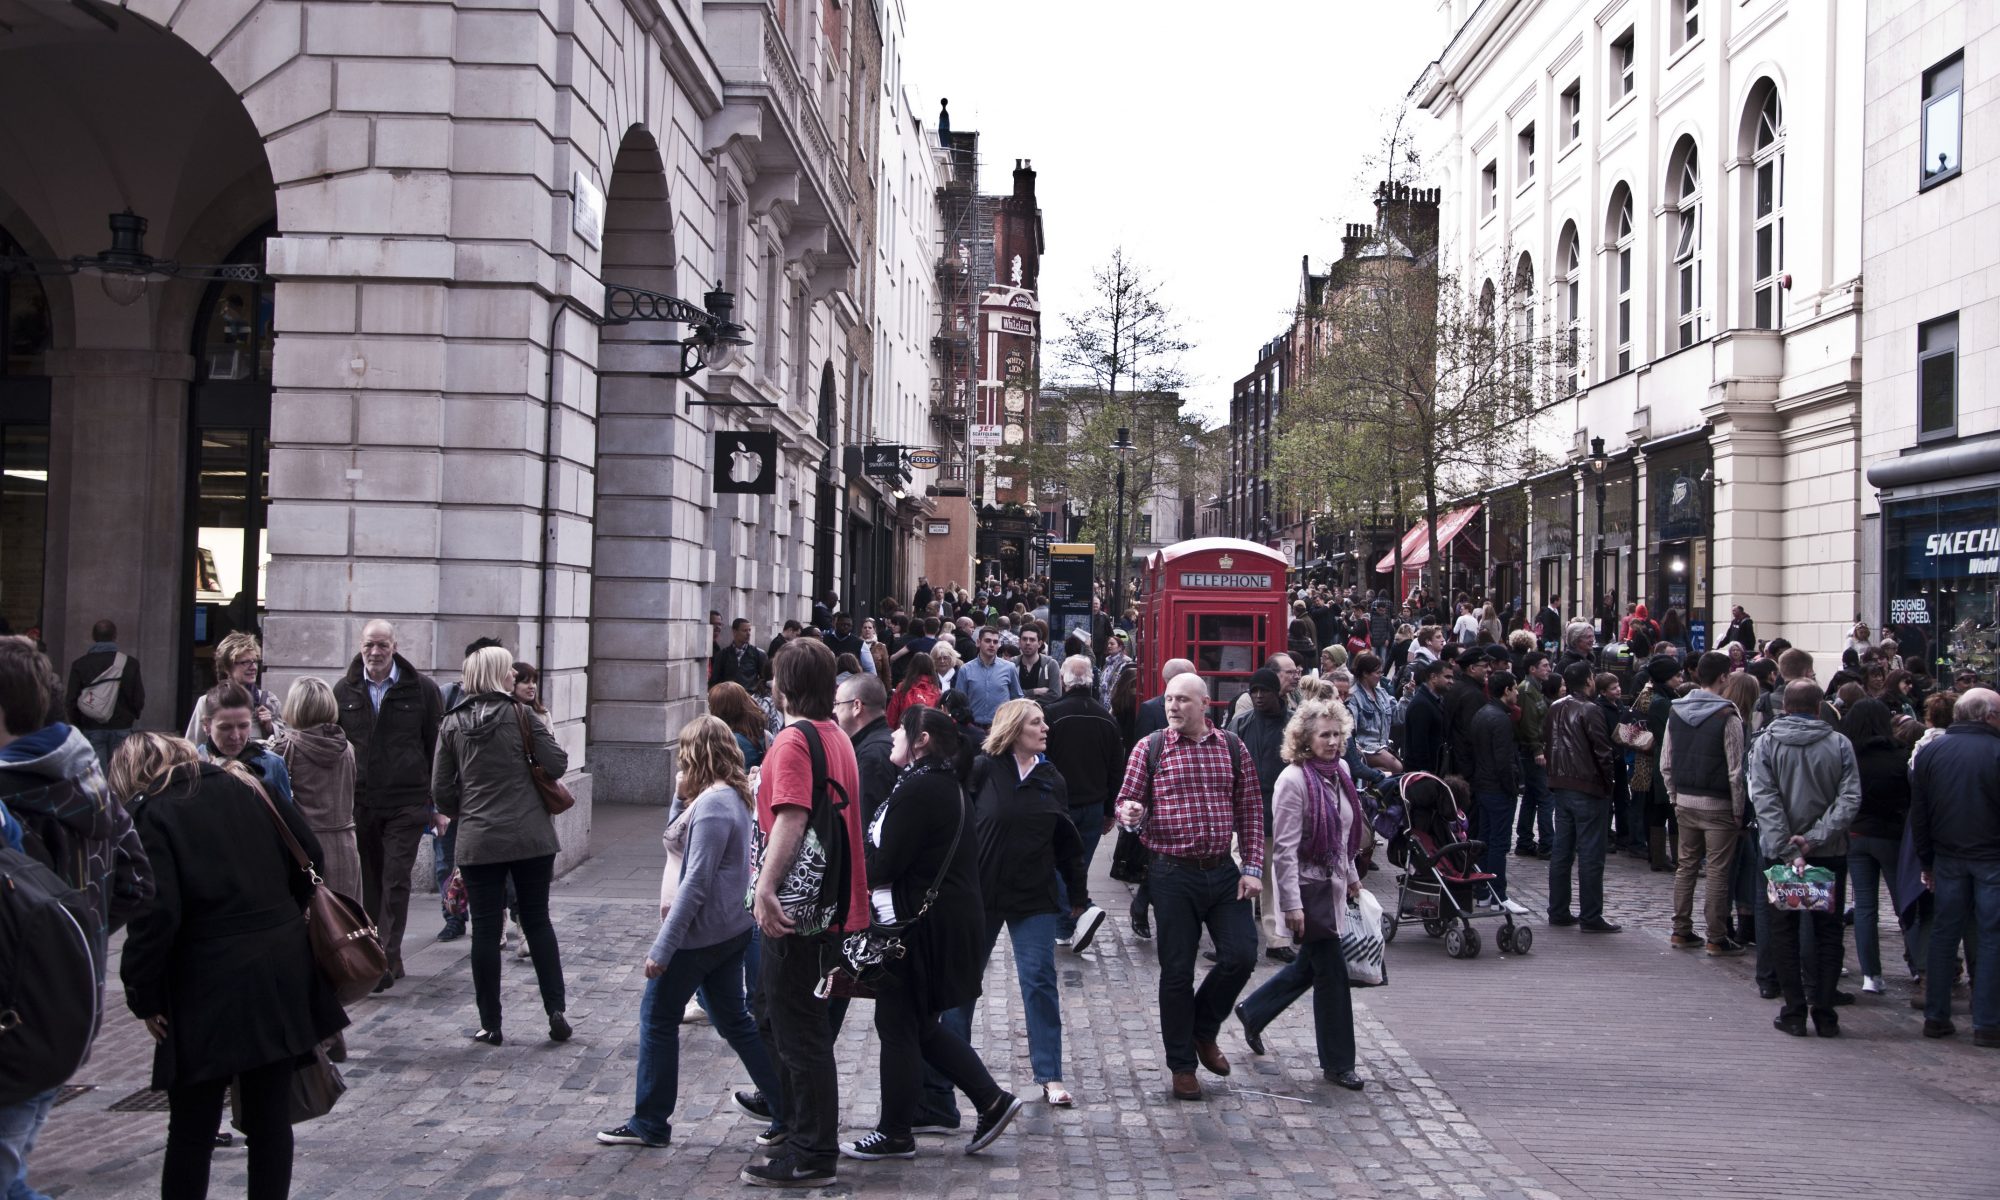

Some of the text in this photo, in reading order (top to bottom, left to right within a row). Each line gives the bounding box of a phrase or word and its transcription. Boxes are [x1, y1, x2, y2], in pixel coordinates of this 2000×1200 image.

[1006, 358, 1025, 368] WHITE
[1969, 557, 1998, 574] World
[1183, 574, 1268, 588] TELEPHONE
[1891, 599, 1926, 611] DESIGNED
[1891, 612, 1931, 623] FOR SPEED.
[1776, 888, 1806, 897] ISLAND
